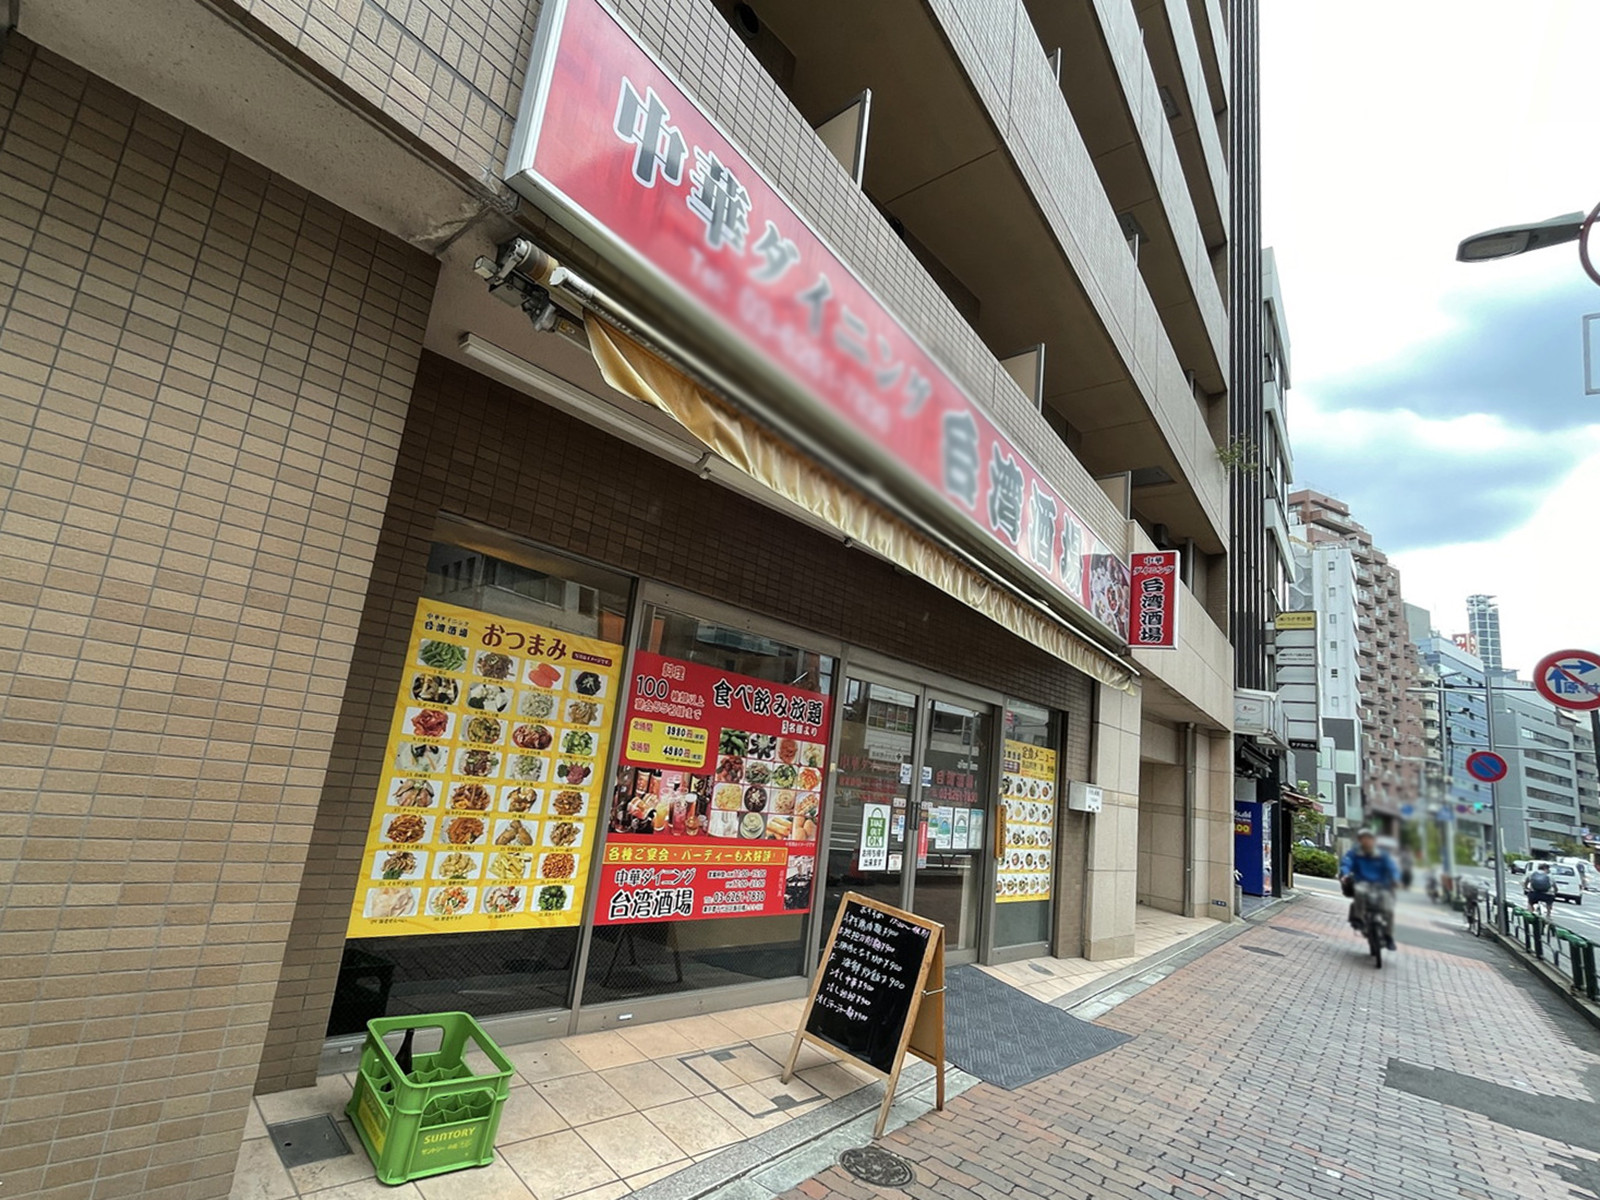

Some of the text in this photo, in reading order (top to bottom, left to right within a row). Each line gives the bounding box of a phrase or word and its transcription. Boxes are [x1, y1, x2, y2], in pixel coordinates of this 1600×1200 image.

[1143, 555, 1164, 566] 中華
[1139, 577, 1164, 643] 台湾酒場
[481, 623, 567, 661] おつまみ
[637, 675, 669, 699] 100
[712, 678, 824, 726] 食べ飲み放題
[614, 867, 696, 887] 中華ダイニング
[608, 886, 694, 920] 台湾酒場
[423, 1127, 476, 1145] SUNTORY
